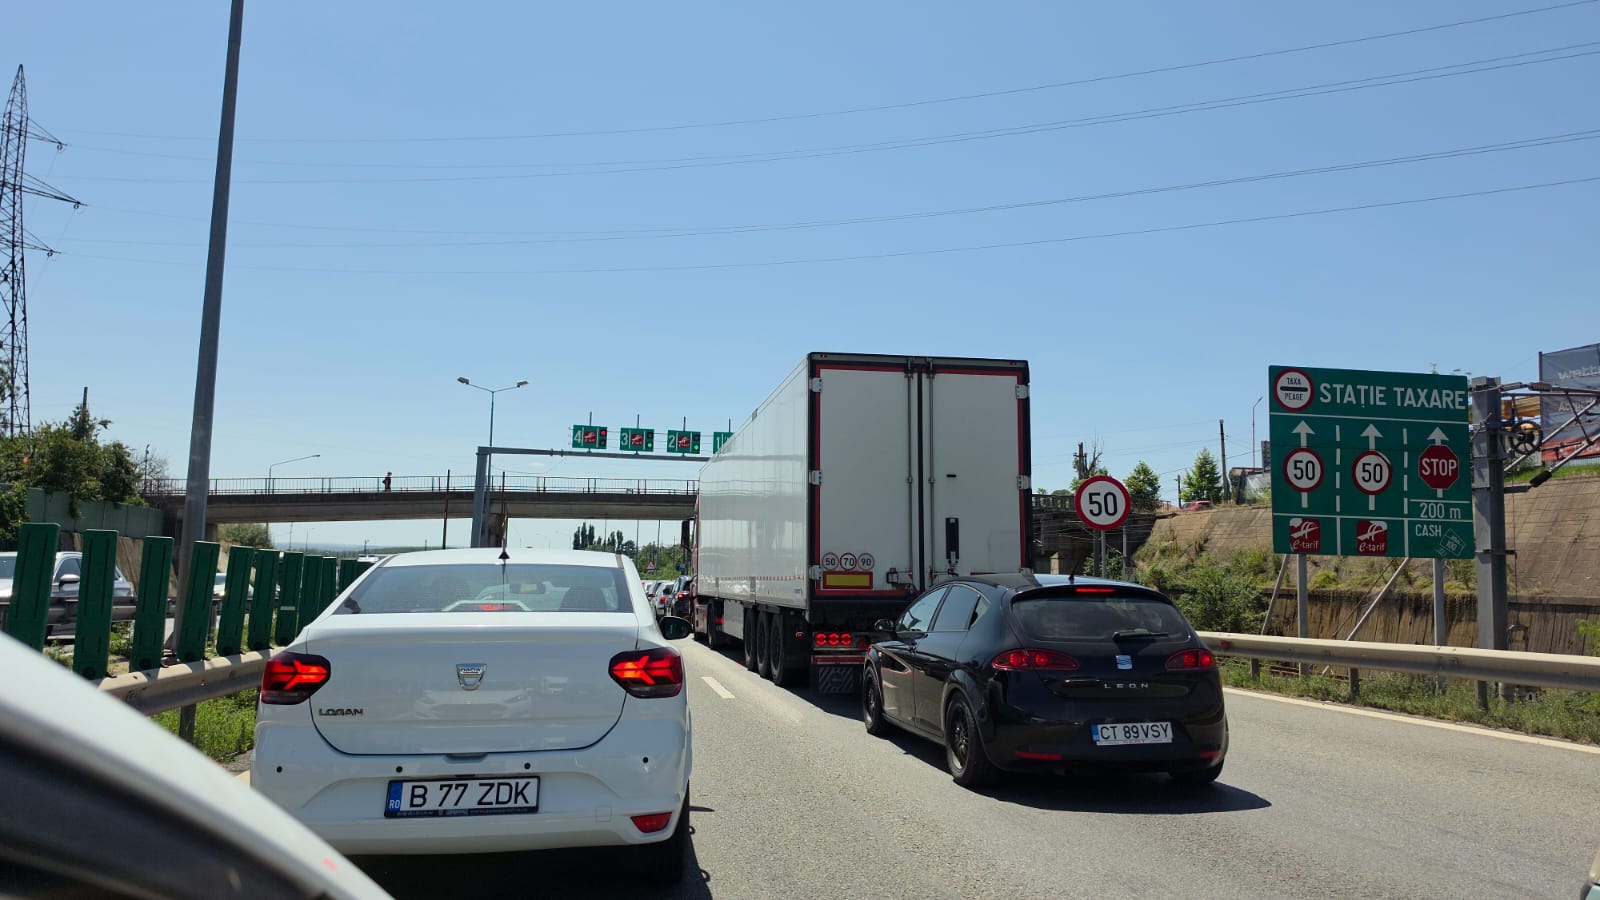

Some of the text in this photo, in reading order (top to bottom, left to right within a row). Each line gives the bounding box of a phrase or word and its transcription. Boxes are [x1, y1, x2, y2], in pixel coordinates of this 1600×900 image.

[1286, 377, 1302, 385] TAXA
[1393, 387, 1466, 410] TAXARE
[574, 430, 582, 444] 4
[620, 432, 629, 446] 3
[668, 434, 676, 448] 2
[1293, 460, 1316, 481] 50
[1361, 463, 1383, 484] 50
[1421, 458, 1457, 477] STOP
[1088, 491, 1118, 517] 50
[1419, 502, 1461, 519] 200 m
[1415, 523, 1442, 537] CASH
[825, 557, 836, 566] 50
[843, 557, 855, 566] 70
[860, 558, 871, 566] 90
[319, 708, 363, 716] LOGAN
[1100, 725, 1118, 740] CT
[389, 781, 531, 809] RO B 77 ZDK
